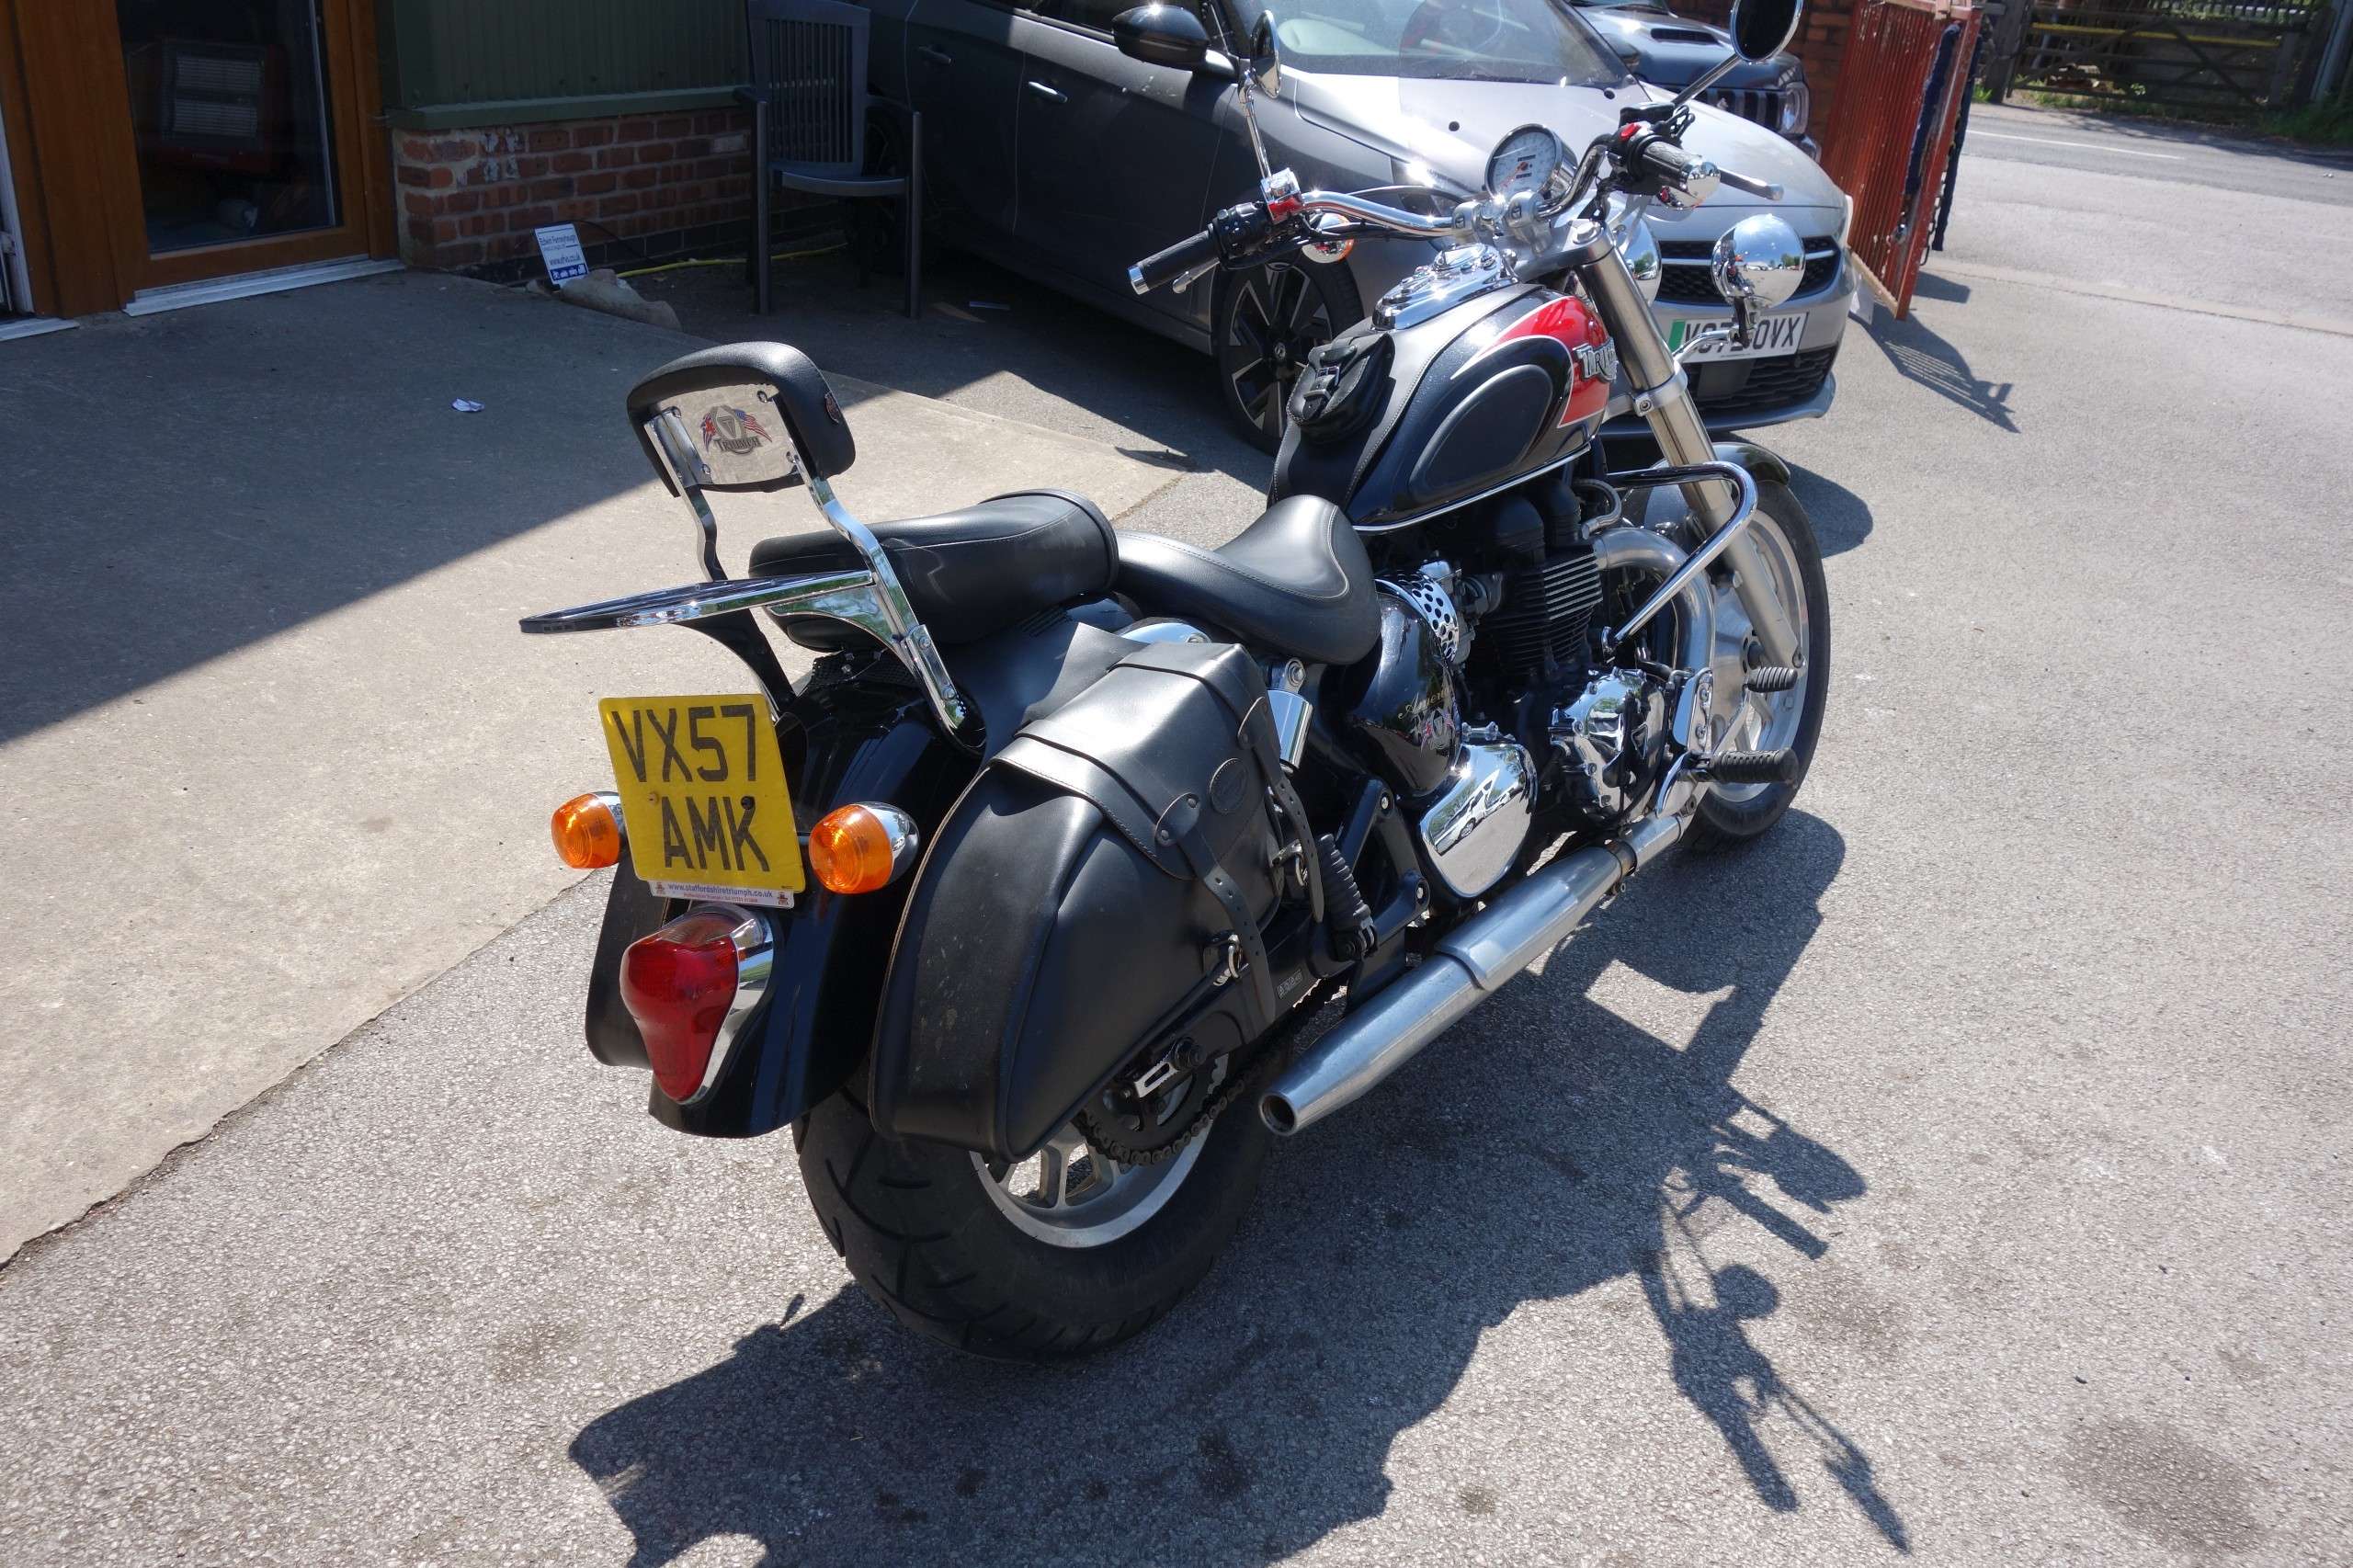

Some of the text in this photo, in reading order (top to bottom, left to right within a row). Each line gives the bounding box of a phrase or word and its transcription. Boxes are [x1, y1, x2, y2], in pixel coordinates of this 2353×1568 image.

[1753, 316, 1801, 349] OVX
[712, 435, 763, 454] TRIUMPH
[611, 703, 756, 783] VX57
[661, 795, 770, 872] AMK
